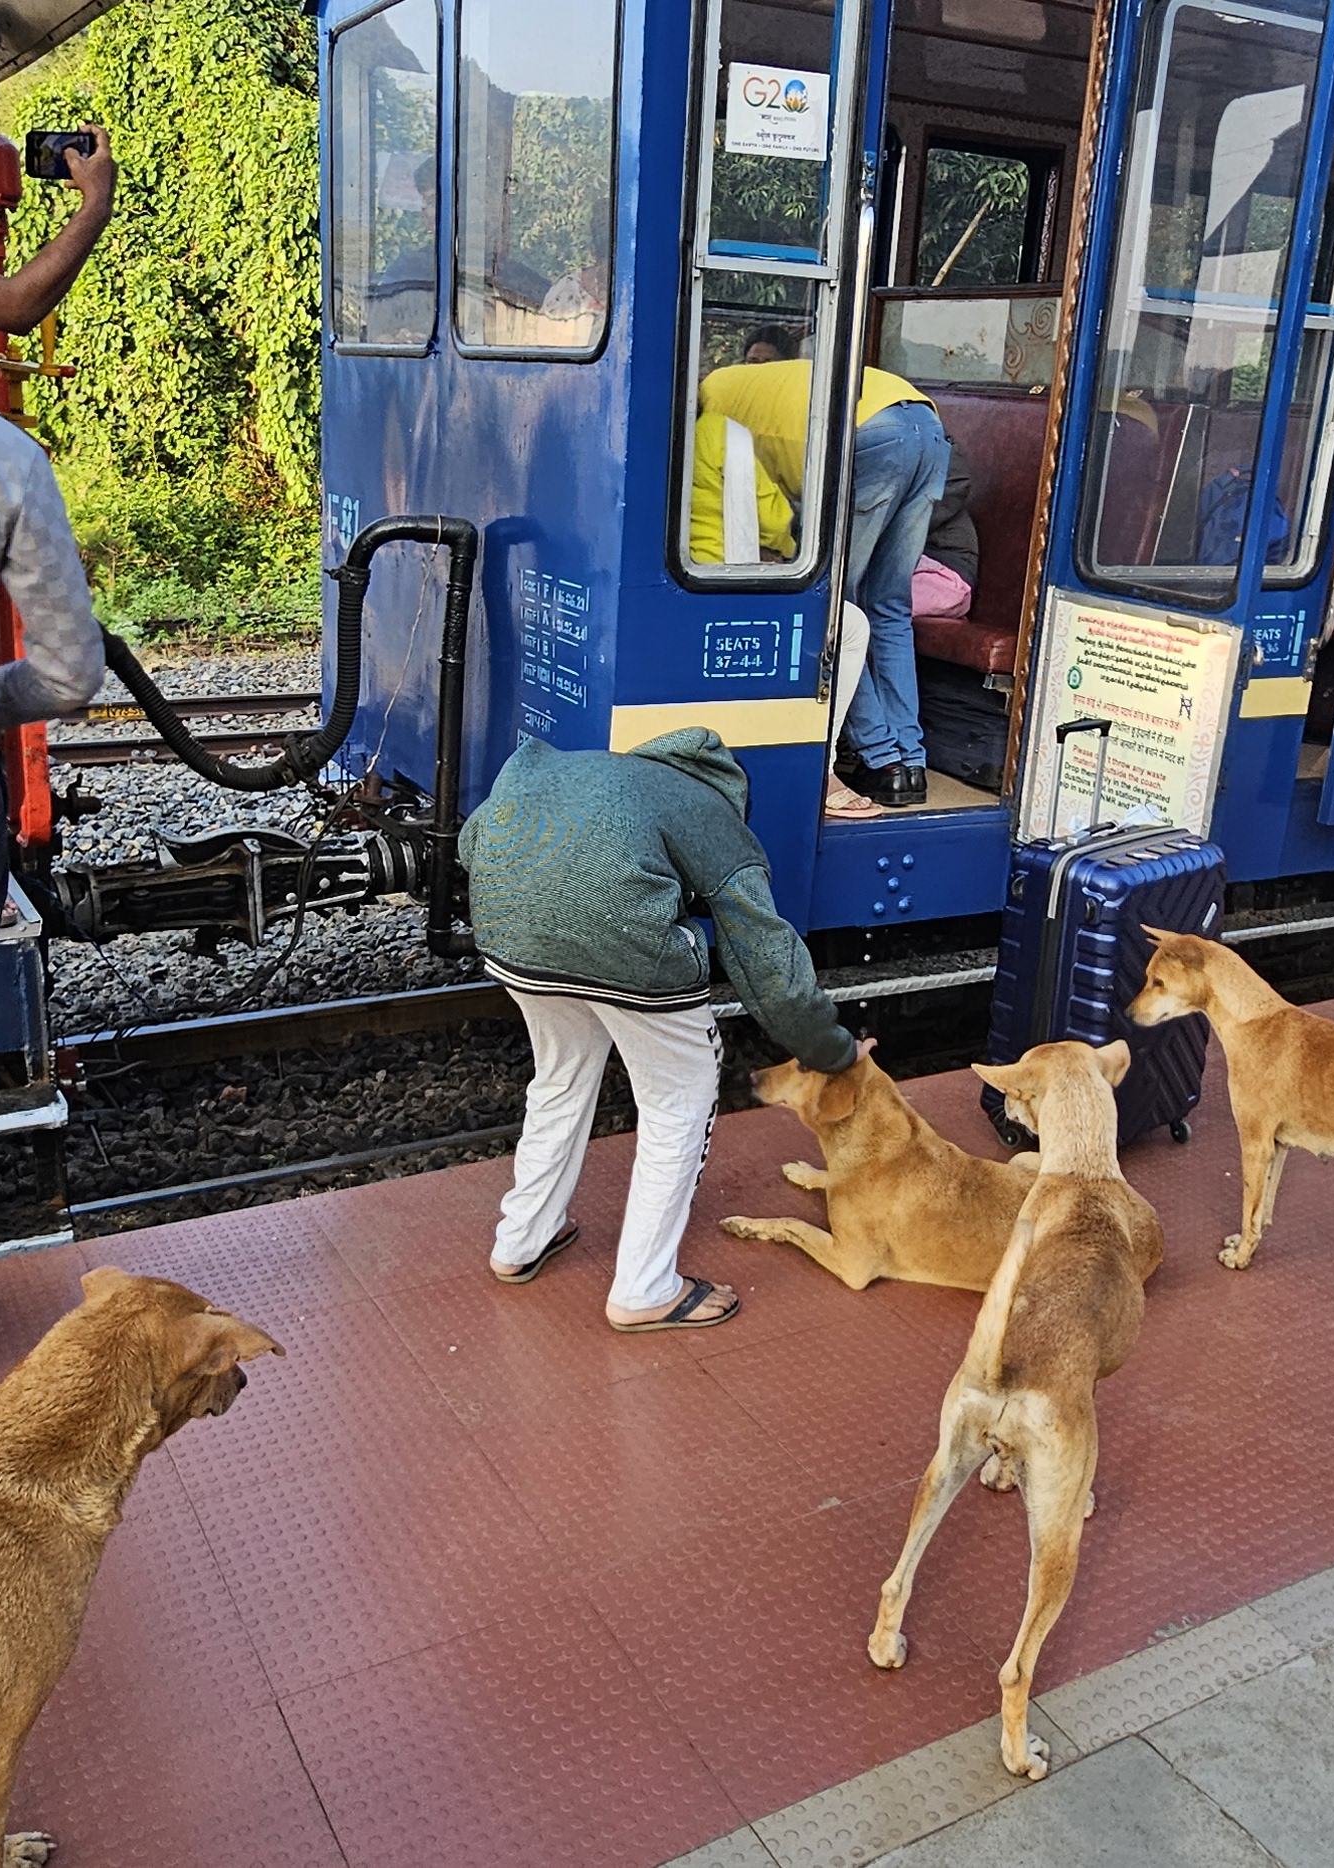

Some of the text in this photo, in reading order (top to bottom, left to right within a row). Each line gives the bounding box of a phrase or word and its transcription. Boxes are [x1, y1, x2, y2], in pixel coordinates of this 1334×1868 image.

[742, 76, 810, 114] G20
[1253, 628, 1282, 641] EATS
[715, 637, 760, 651] SEATS
[715, 654, 763, 669] 37-44
[1065, 761, 1080, 774] Drop
[1121, 781, 1132, 791] the
[1132, 784, 1171, 804] designated
